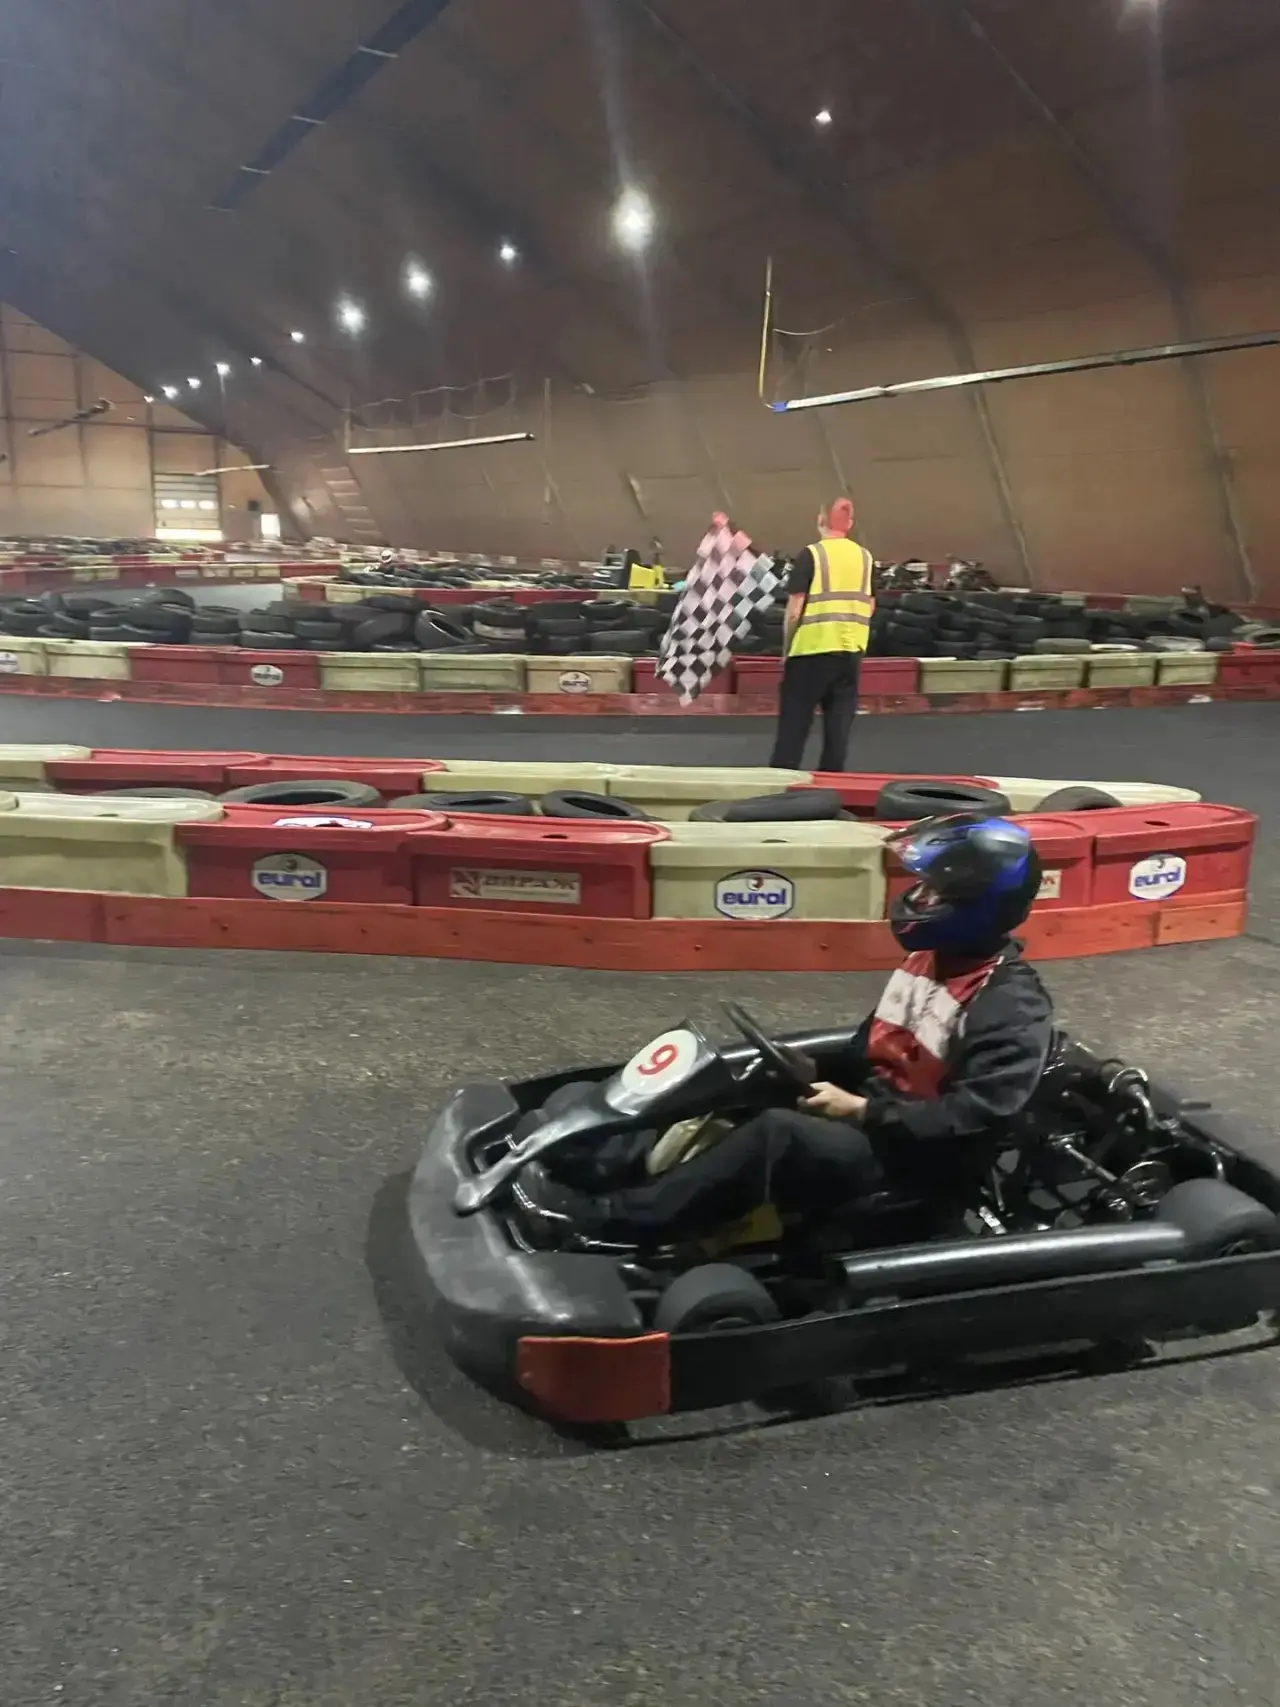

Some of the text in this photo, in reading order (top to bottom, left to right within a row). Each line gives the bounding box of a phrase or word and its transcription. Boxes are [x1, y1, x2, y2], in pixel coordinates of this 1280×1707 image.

[258, 872, 321, 889] eurol
[1135, 866, 1181, 888] eurol
[723, 888, 786, 905] eurol
[637, 1044, 677, 1075] 9
